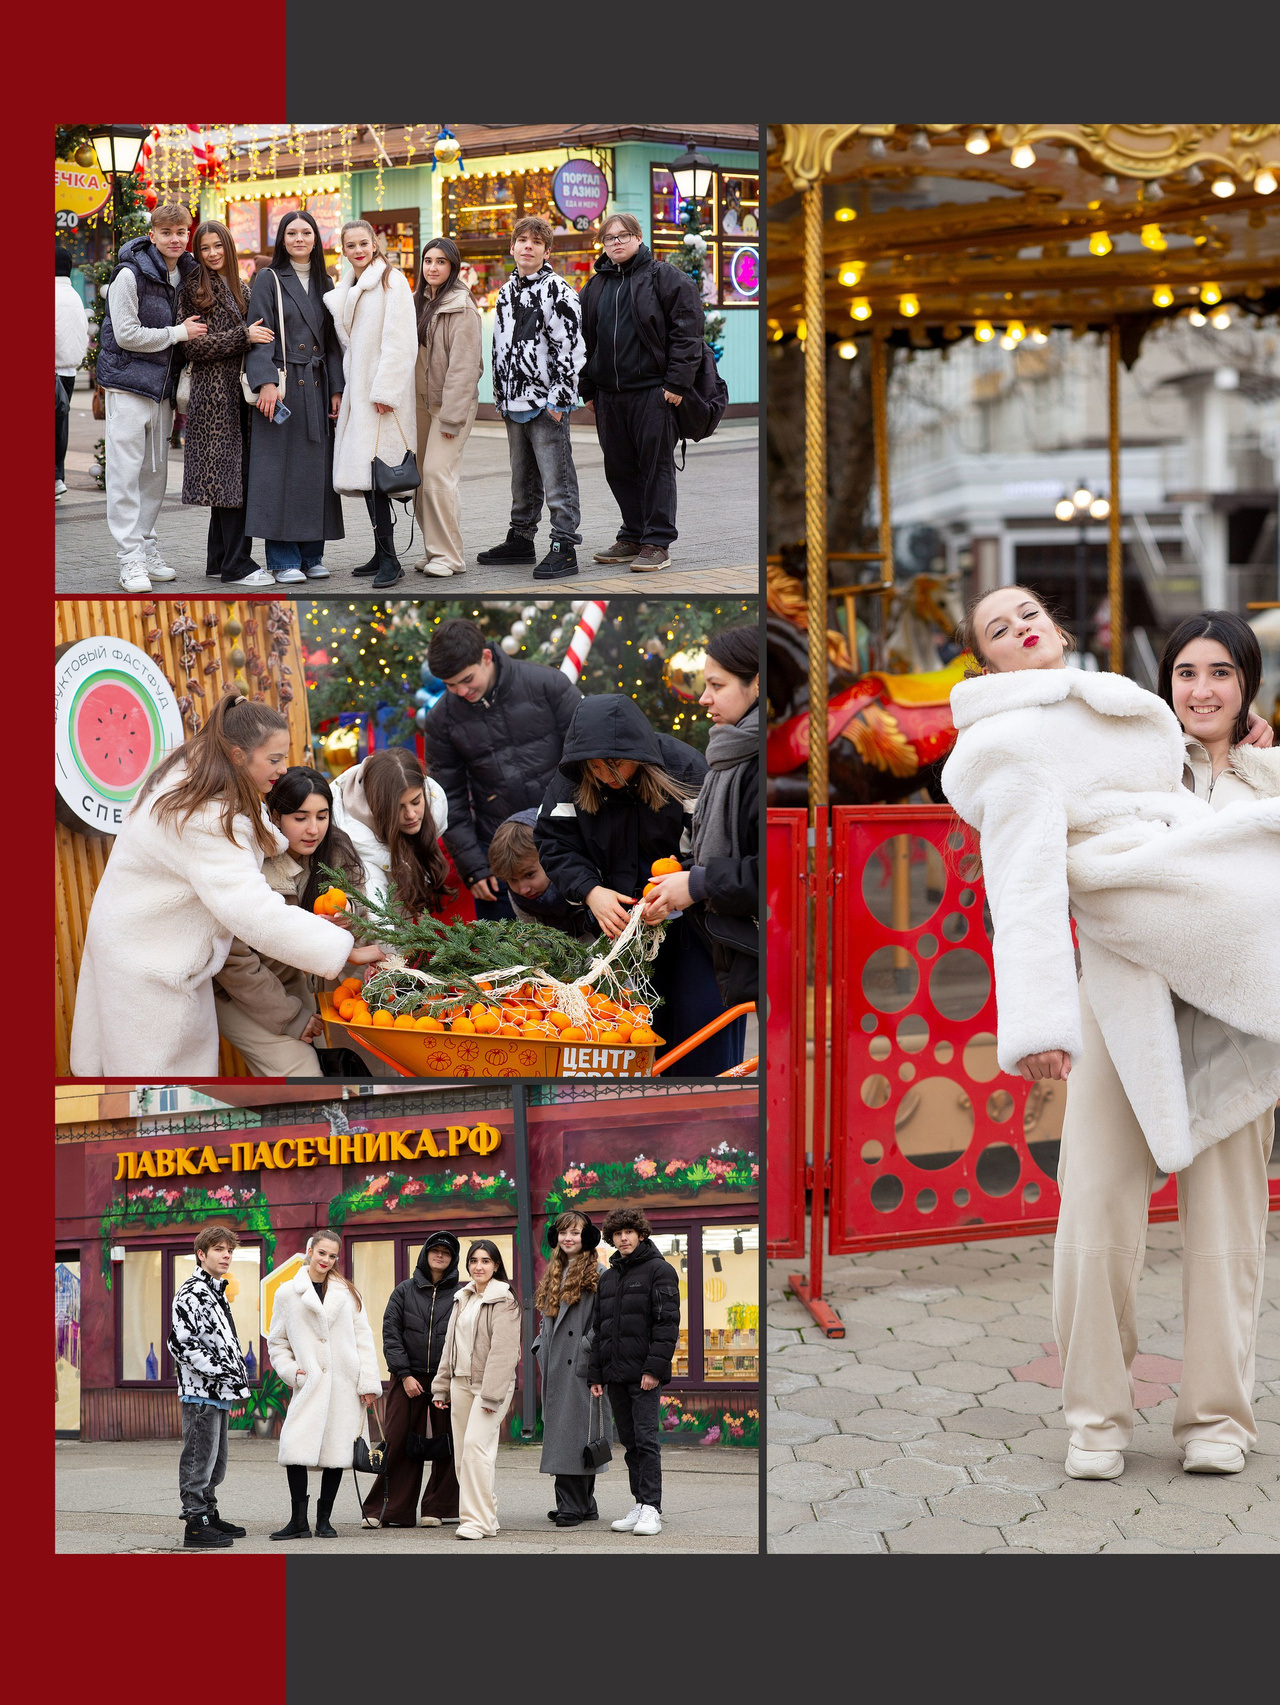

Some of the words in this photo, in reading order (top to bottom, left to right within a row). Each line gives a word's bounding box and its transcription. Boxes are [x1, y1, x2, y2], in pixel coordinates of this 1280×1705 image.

[562, 172, 600, 185] ПОРТАЛ
[563, 185, 570, 196] В
[572, 185, 600, 198] АЗИЮ
[565, 200, 577, 208] ЕДА
[56, 211, 79, 227] 20
[576, 217, 589, 229] 26
[112, 649, 169, 710] ФАСТФУД
[563, 1047, 636, 1070] ЦЕНТР
[114, 1122, 502, 1180] ЛАВКА-ПАСЕЧНИКА.РФ
